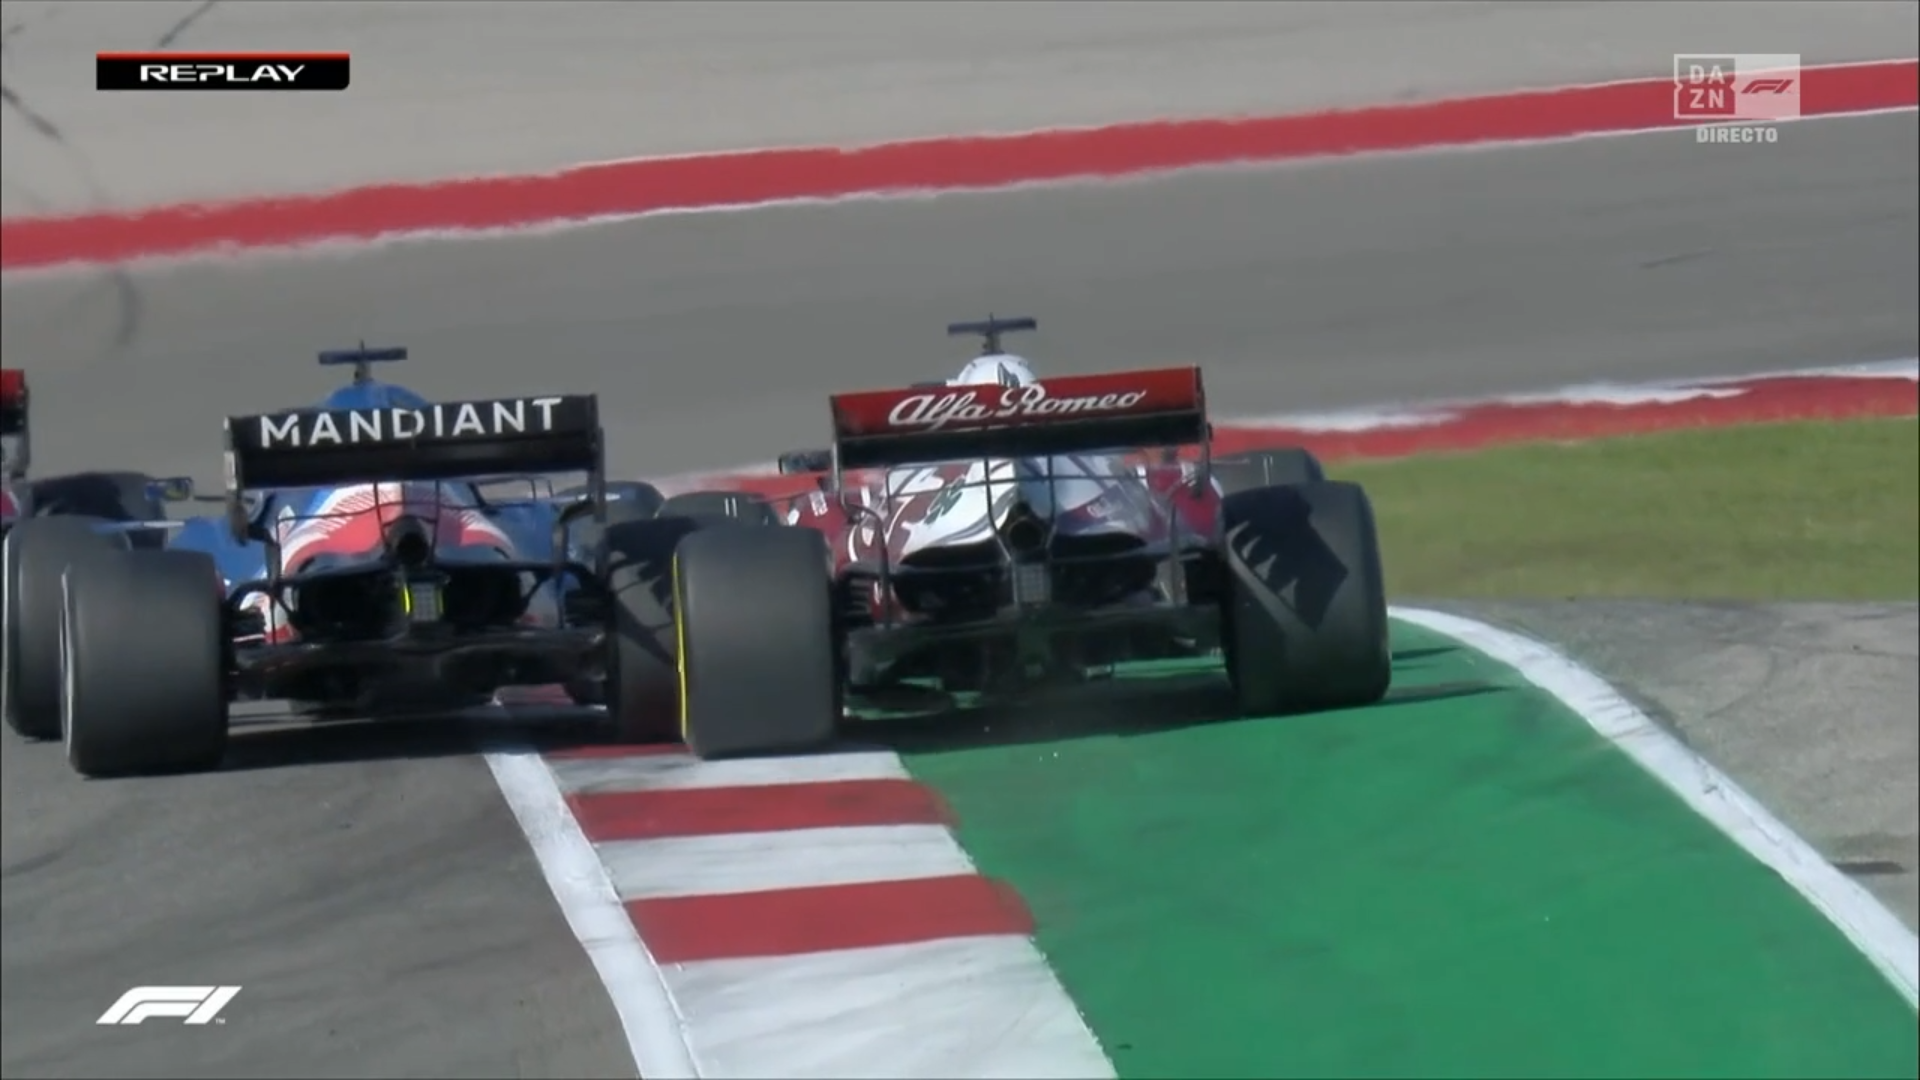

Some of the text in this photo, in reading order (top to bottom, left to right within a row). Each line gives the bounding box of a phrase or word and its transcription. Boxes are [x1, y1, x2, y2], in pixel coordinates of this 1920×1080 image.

[260, 397, 562, 448] MANDIANT
[888, 383, 1147, 431] Alfa Romeo
